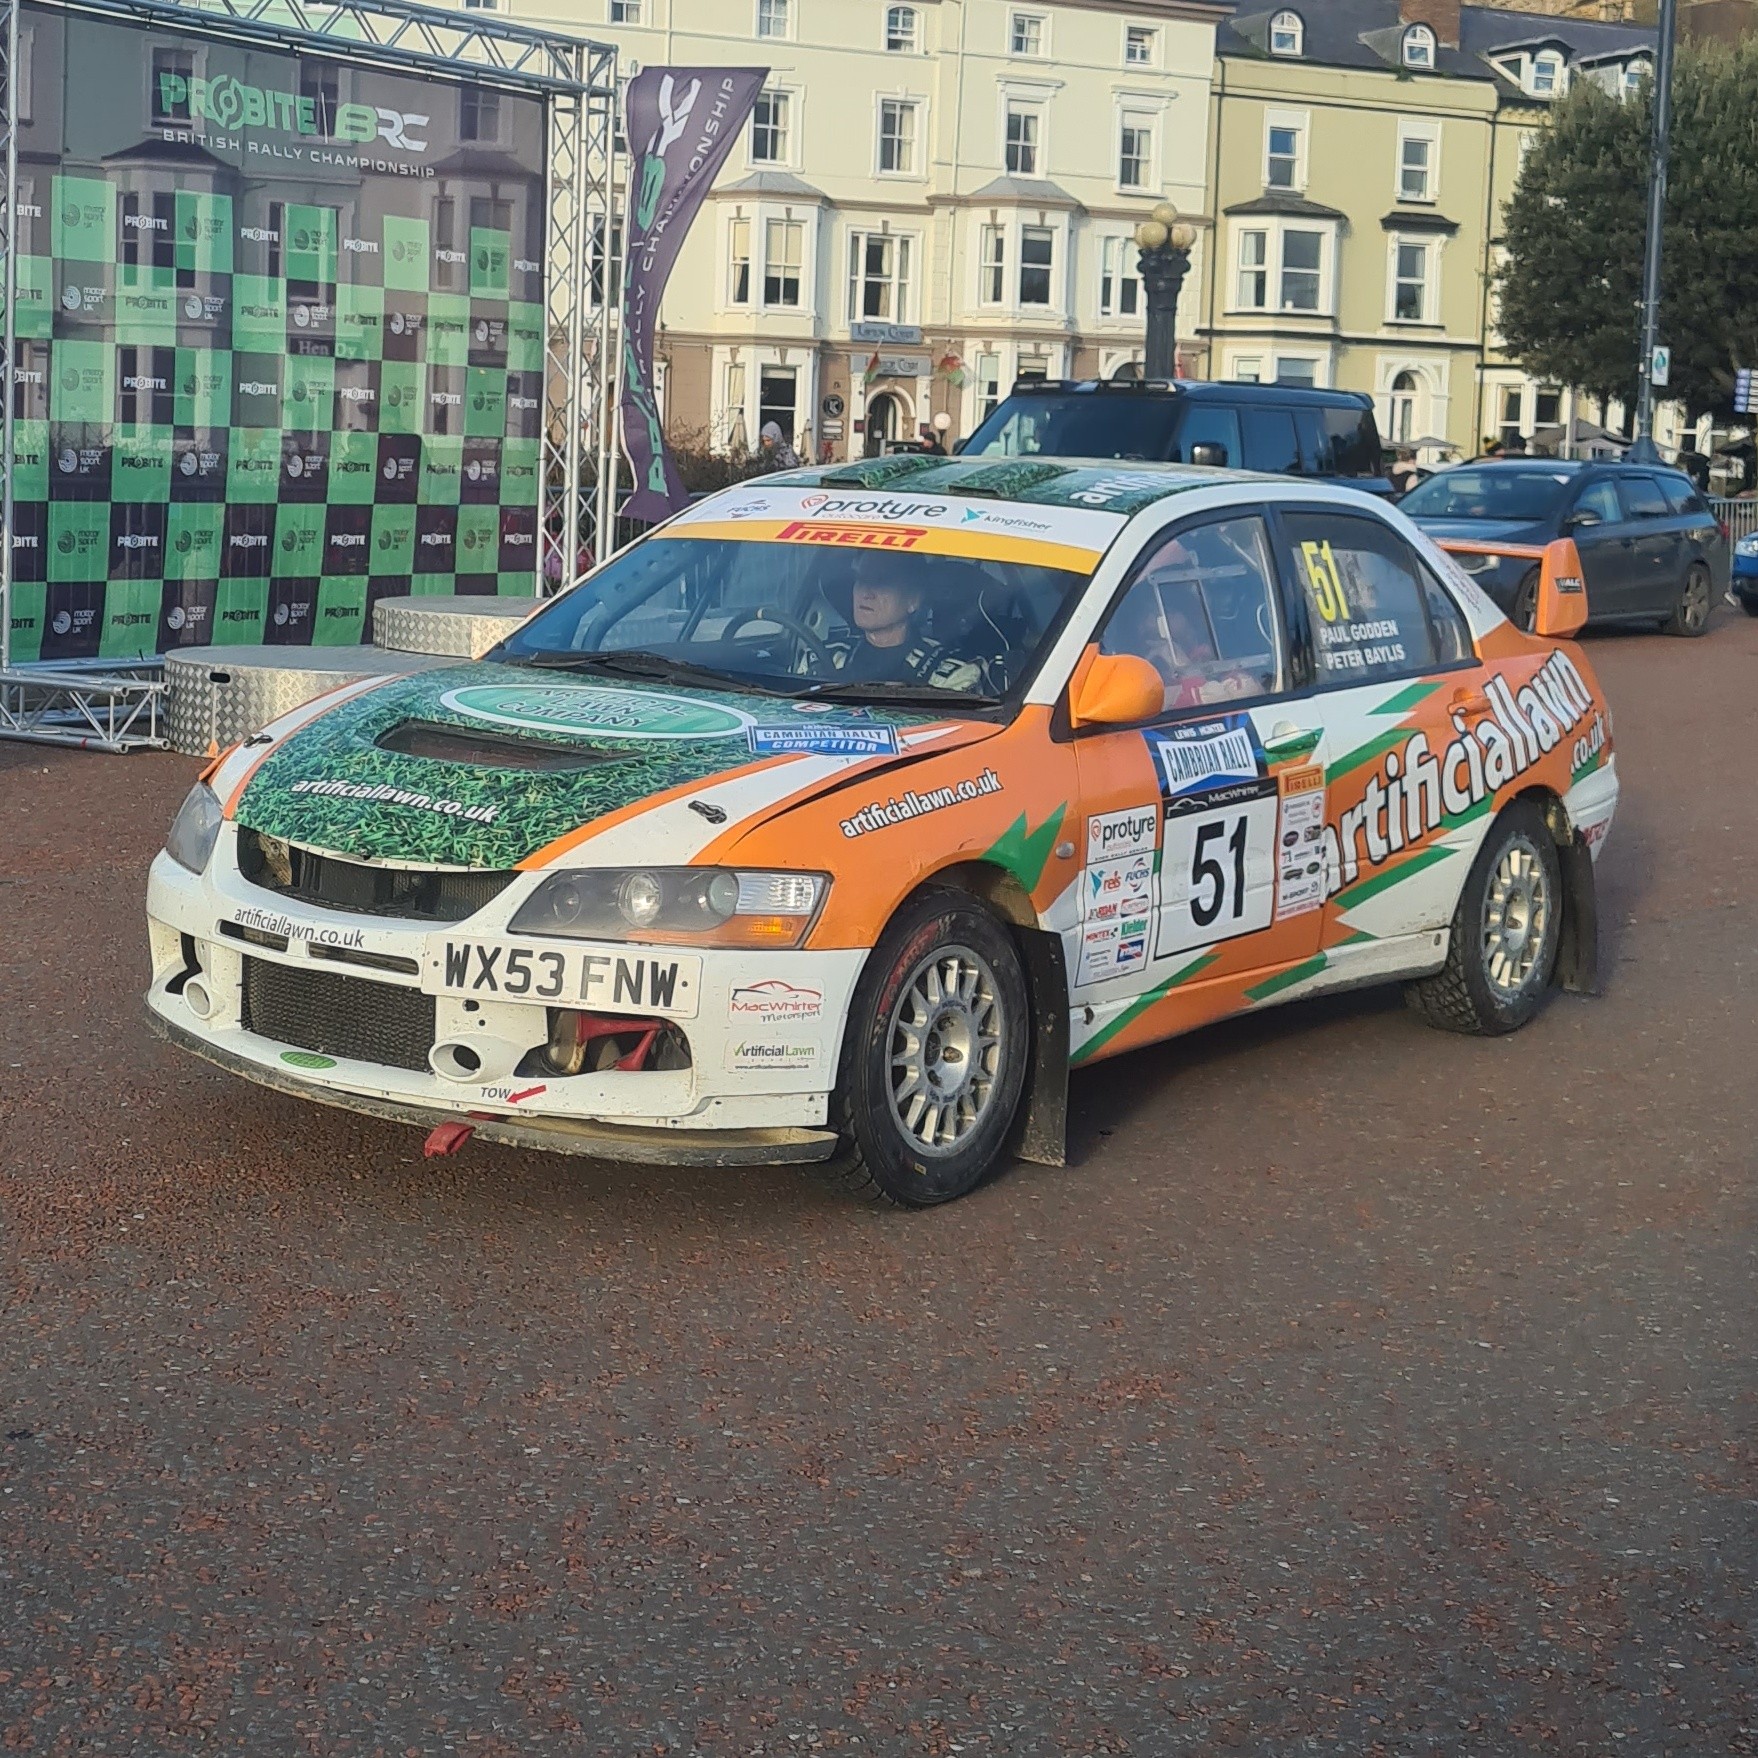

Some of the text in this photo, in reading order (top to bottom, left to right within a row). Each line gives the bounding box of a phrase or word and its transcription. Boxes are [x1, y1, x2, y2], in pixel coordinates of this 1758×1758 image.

[160, 72, 430, 151] PROBITE BRC
[163, 129, 435, 178] BRITISH RALLY CHAMPIONSHIP
[125, 215, 168, 230] PROBITE
[241, 227, 279, 242] PROBITE
[124, 375, 167, 390] PROBITE
[239, 381, 277, 396] PROBITE
[121, 454, 164, 470] PROBITE
[812, 499, 948, 519] protyre
[984, 515, 1053, 530] kingfisher
[117, 533, 158, 548] PROBITE
[230, 533, 268, 548] PROBITE
[330, 533, 366, 547] PROBITE
[775, 521, 928, 547] PIRELLI
[1300, 540, 1350, 622] 51
[222, 609, 260, 622] PROBITE
[324, 604, 360, 618] PROBITE
[1320, 619, 1399, 644] PAUL GODDEN
[1326, 643, 1406, 670] PETER BAYLIS
[497, 701, 650, 727] COMPANY
[538, 688, 687, 717] ARTIFICIAL
[551, 698, 642, 715] LAWN
[763, 729, 882, 740] CAMBRIAN RALLY
[771, 738, 878, 752] COMPETITOR
[1570, 709, 1606, 776] .co.uk
[1165, 735, 1251, 783] CAMBRIAN RALLY
[1323, 647, 1594, 902] artificiallawn
[289, 778, 501, 824] artificiallawn.co.uk
[839, 767, 1004, 838] artificiallawn.co.uk
[1102, 815, 1155, 849] protyre
[1125, 868, 1150, 882] FUCHS
[1190, 815, 1248, 926] 51
[234, 907, 364, 949] artificiallawn.co.uk
[443, 942, 679, 1009] WX53 FNW
[731, 1001, 822, 1012] MacWhirter
[761, 1010, 821, 1022] Motorsport
[480, 1086, 511, 1099] TOW
